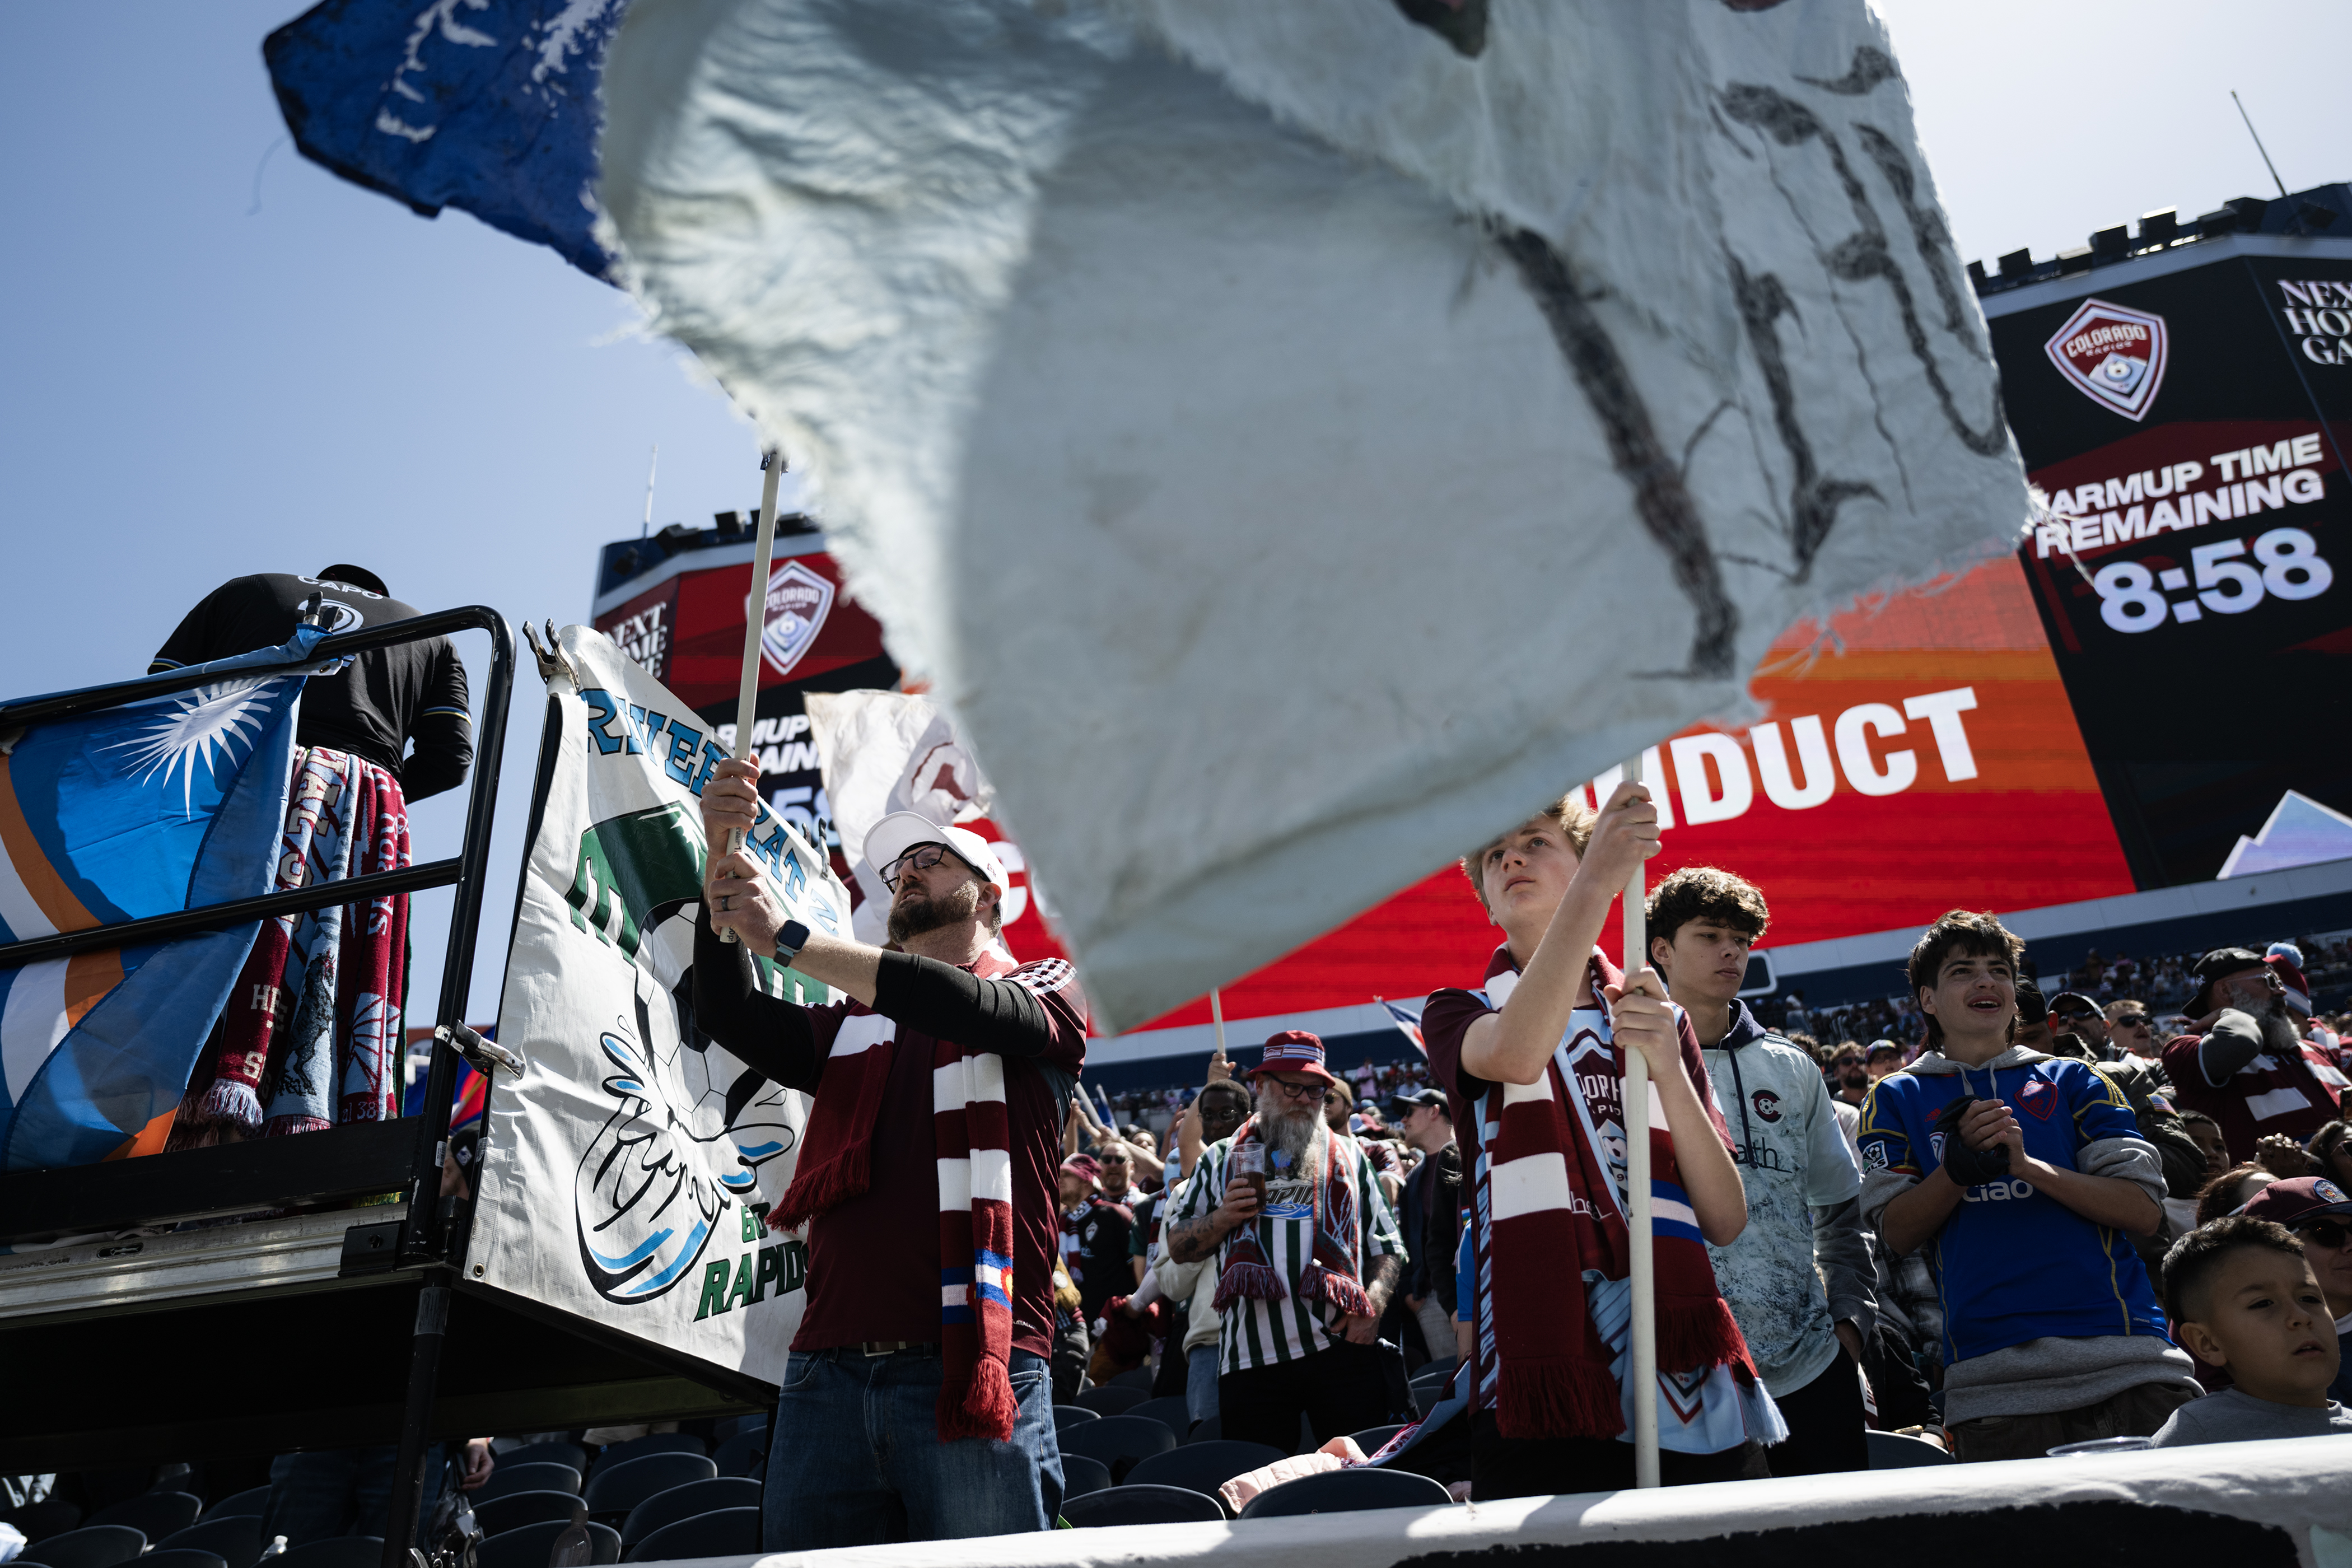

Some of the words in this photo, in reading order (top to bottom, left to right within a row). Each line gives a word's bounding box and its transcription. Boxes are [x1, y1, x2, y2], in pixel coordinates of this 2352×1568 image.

[2281, 307, 2352, 337] HO
[2065, 323, 2149, 358] COLORADO
[2210, 432, 2323, 483] TIME
[2035, 470, 2325, 559] REMAINING
[298, 575, 384, 600] CAPO
[766, 585, 820, 609] OLORADO
[2093, 527, 2334, 634] 8:58
[357, 1101, 377, 1120] 38
[741, 1202, 771, 1244] GO
